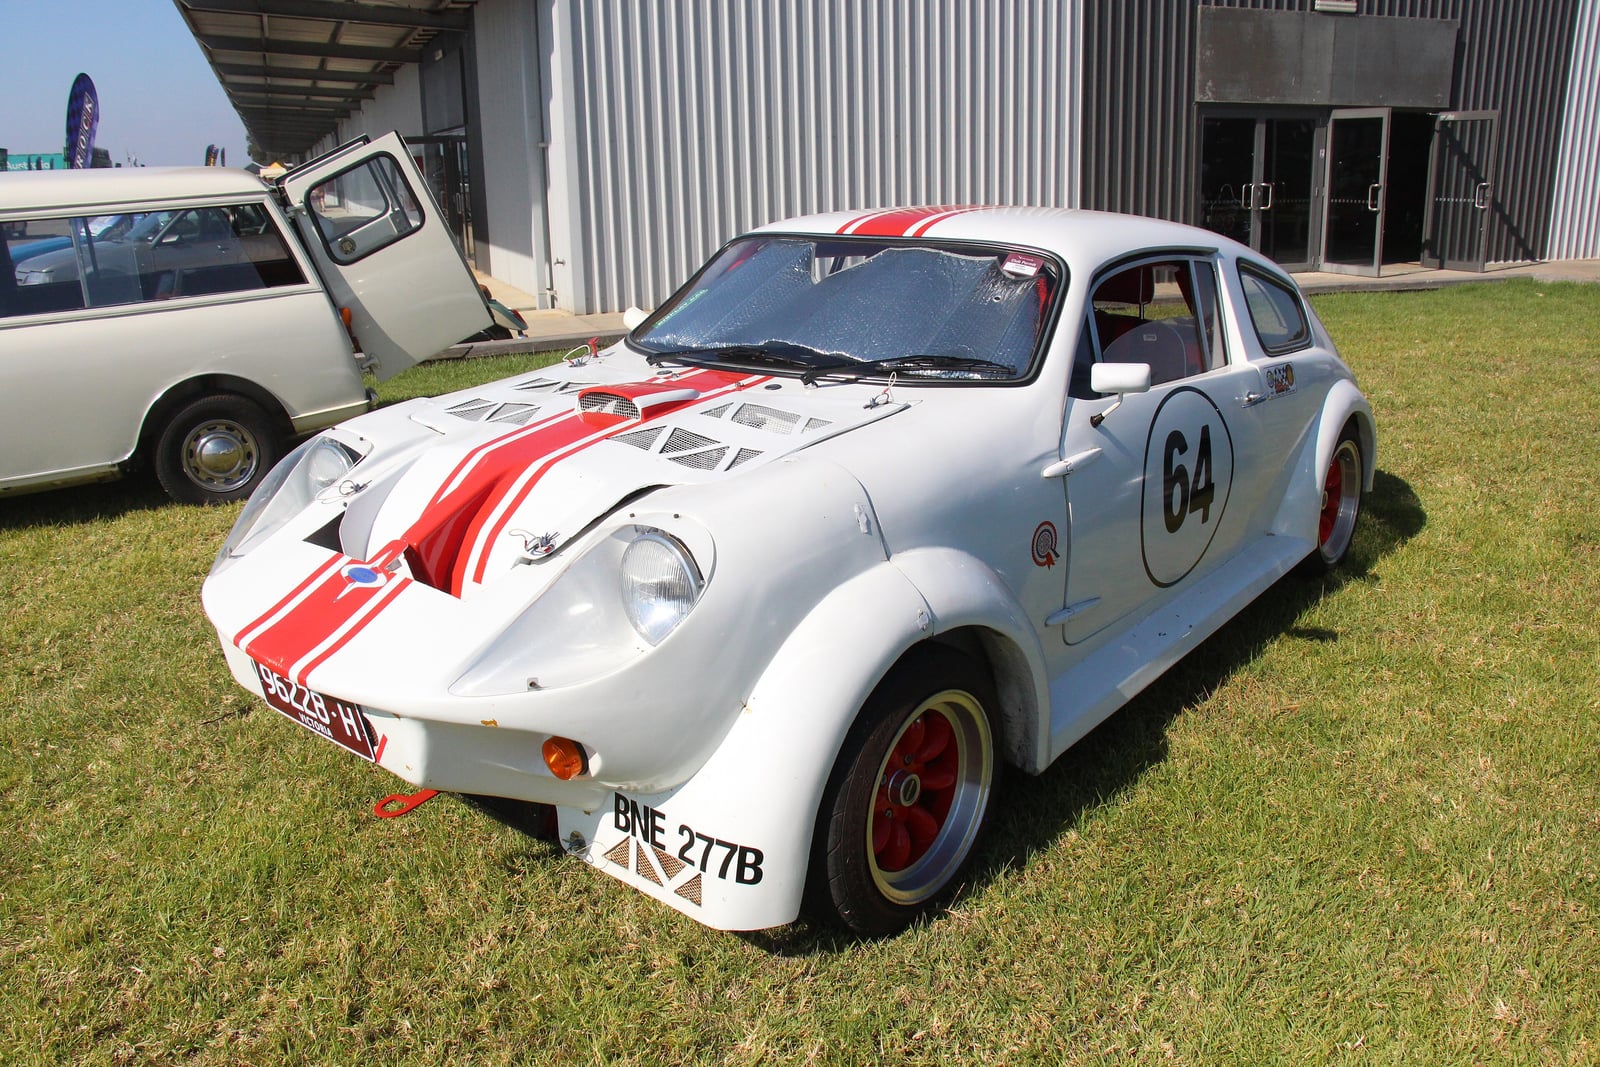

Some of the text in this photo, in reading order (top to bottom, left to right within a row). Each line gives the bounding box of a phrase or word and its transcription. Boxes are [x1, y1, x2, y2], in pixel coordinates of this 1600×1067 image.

[1163, 424, 1215, 534] 64
[298, 711, 333, 738] VICTORIA
[614, 791, 765, 886] BNE 277B
